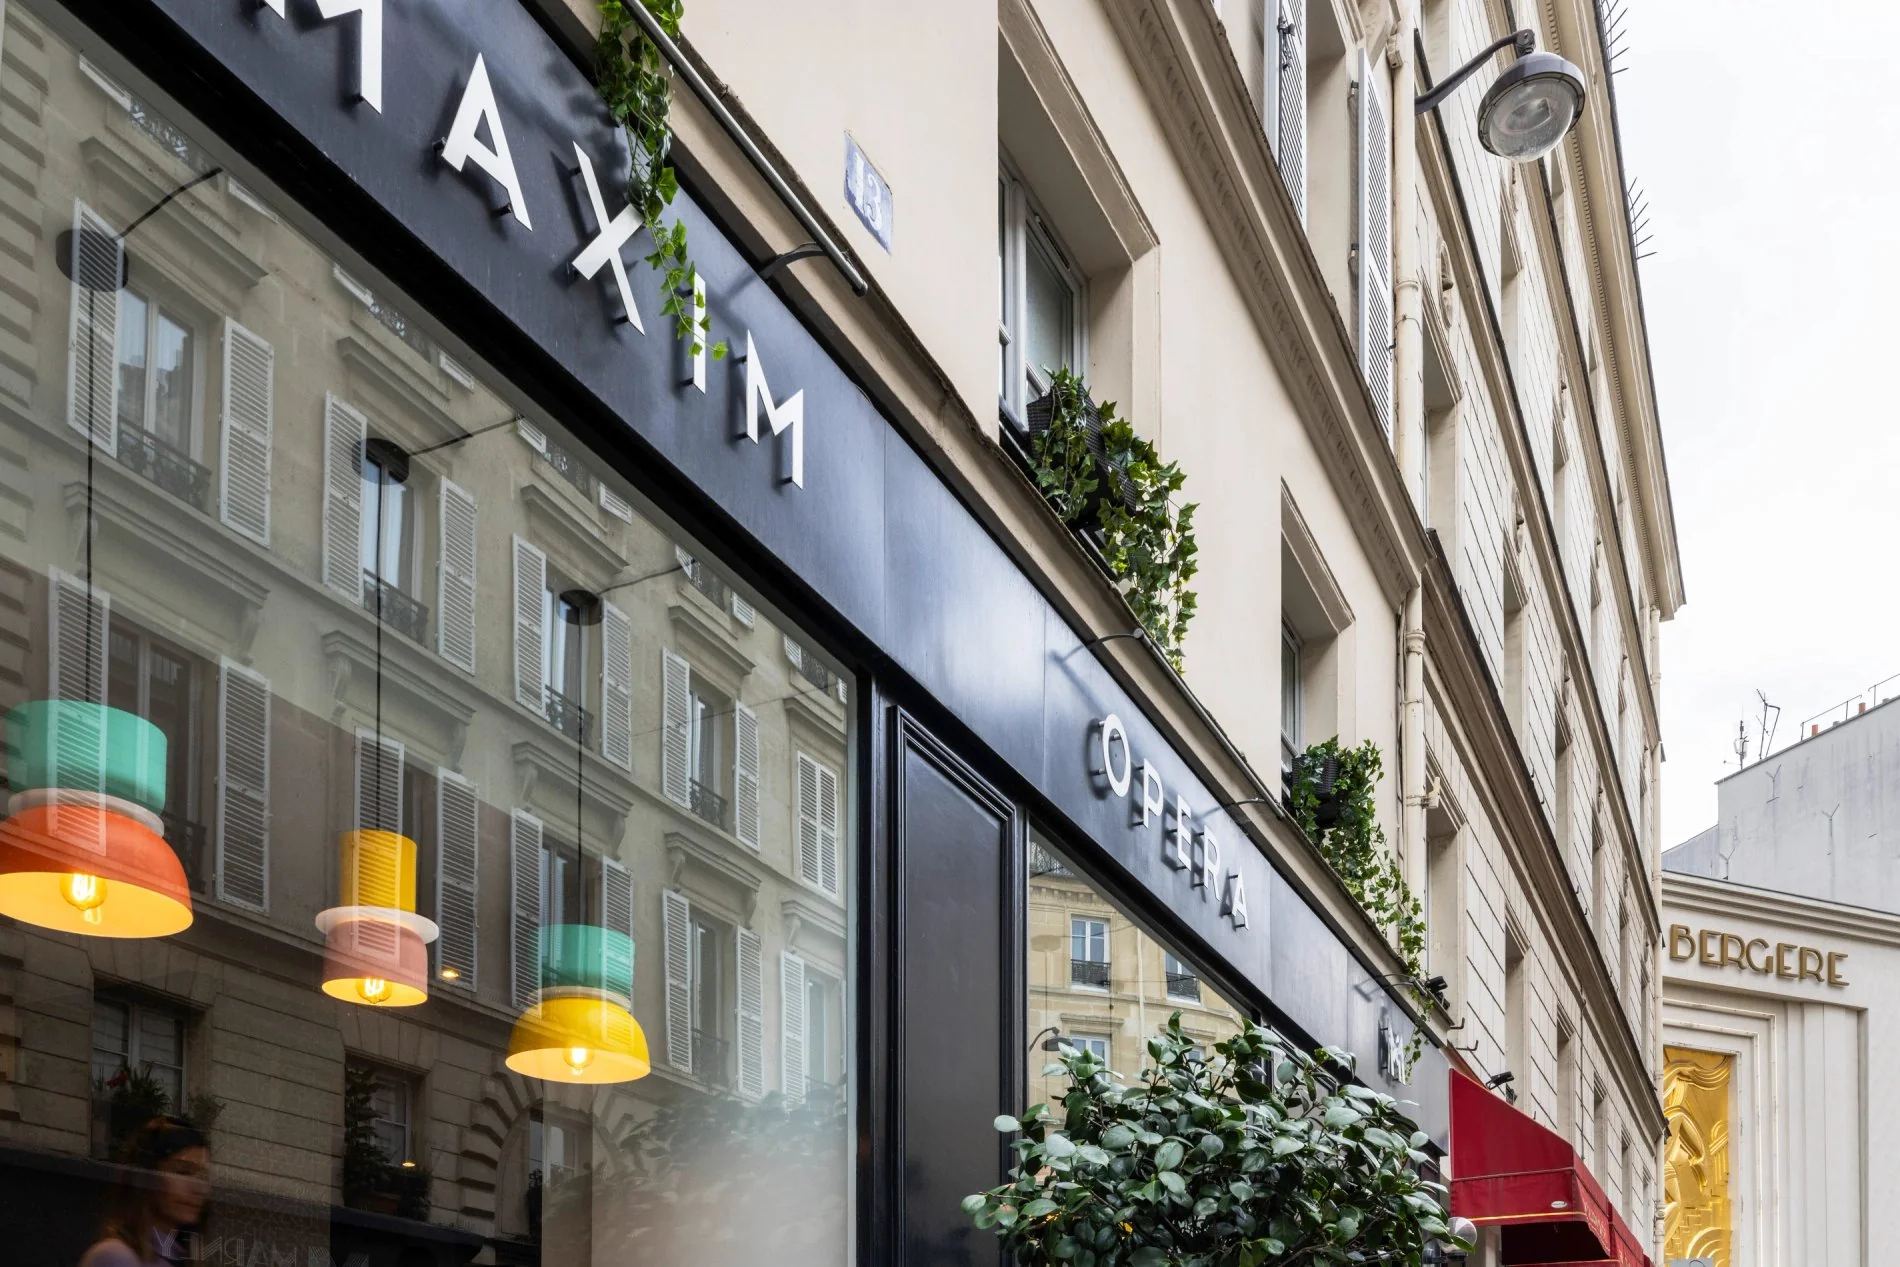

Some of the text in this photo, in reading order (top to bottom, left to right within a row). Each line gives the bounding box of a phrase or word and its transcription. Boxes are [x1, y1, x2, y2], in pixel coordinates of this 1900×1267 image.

[853, 151, 883, 231] 13
[1102, 713, 1250, 931] OPERA
[1670, 923, 1850, 986] BERGERE
